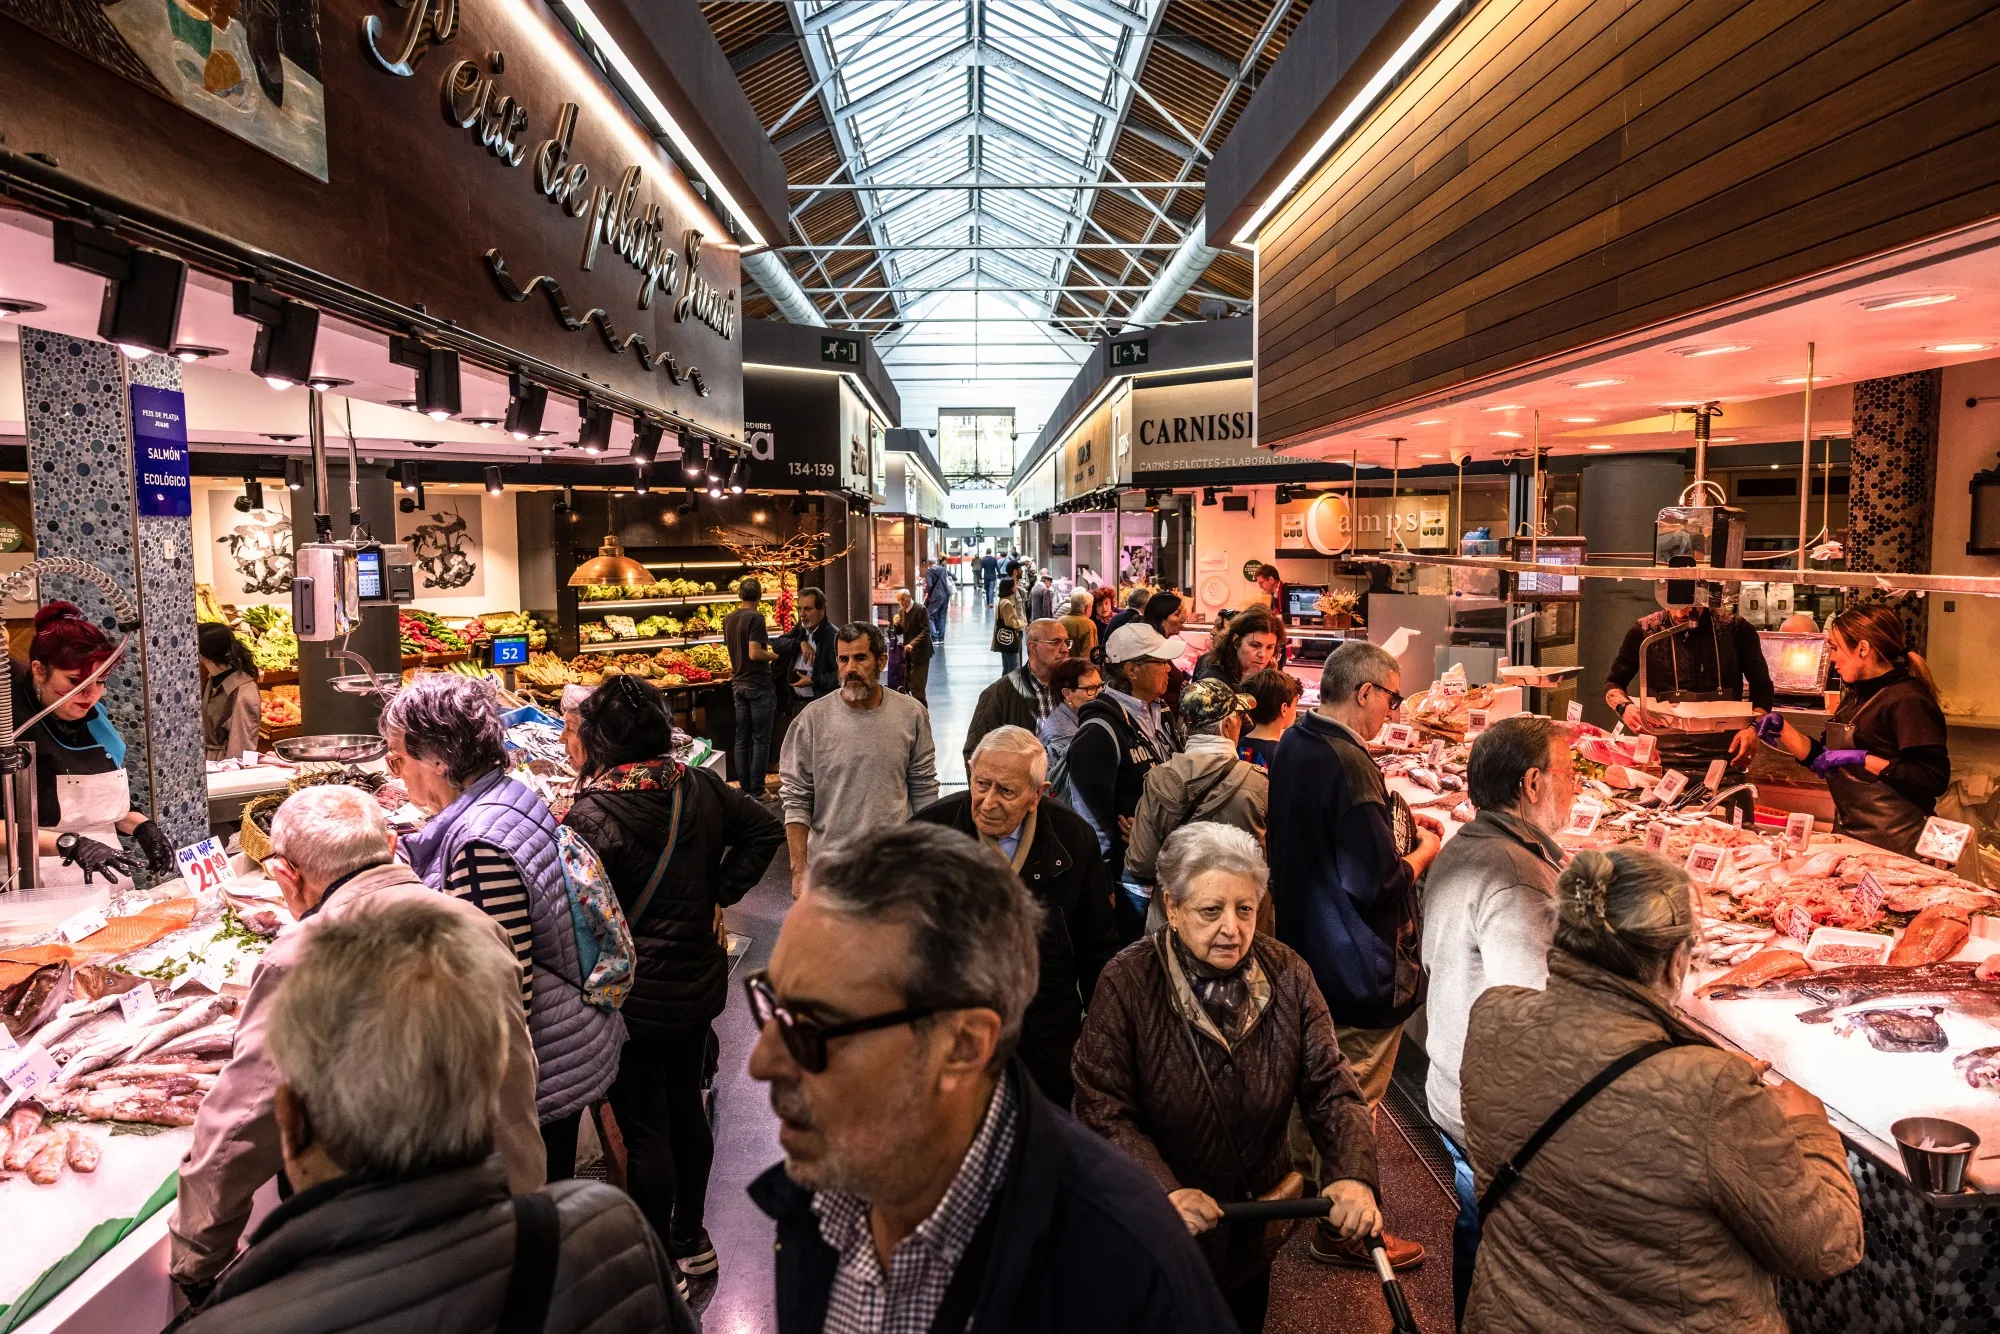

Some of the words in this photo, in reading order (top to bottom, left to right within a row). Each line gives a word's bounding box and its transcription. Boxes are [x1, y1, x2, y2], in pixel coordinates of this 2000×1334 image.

[536, 102, 589, 218] de
[582, 164, 680, 310] platja
[163, 412, 179, 421] PLATJA
[147, 446, 180, 461] SALMÓN
[1139, 461, 1170, 471] CARNS
[143, 471, 187, 487] ECOLÓGICO
[950, 502, 974, 510] Borrell
[980, 502, 1006, 510] Tamarit
[502, 648, 518, 660] 52
